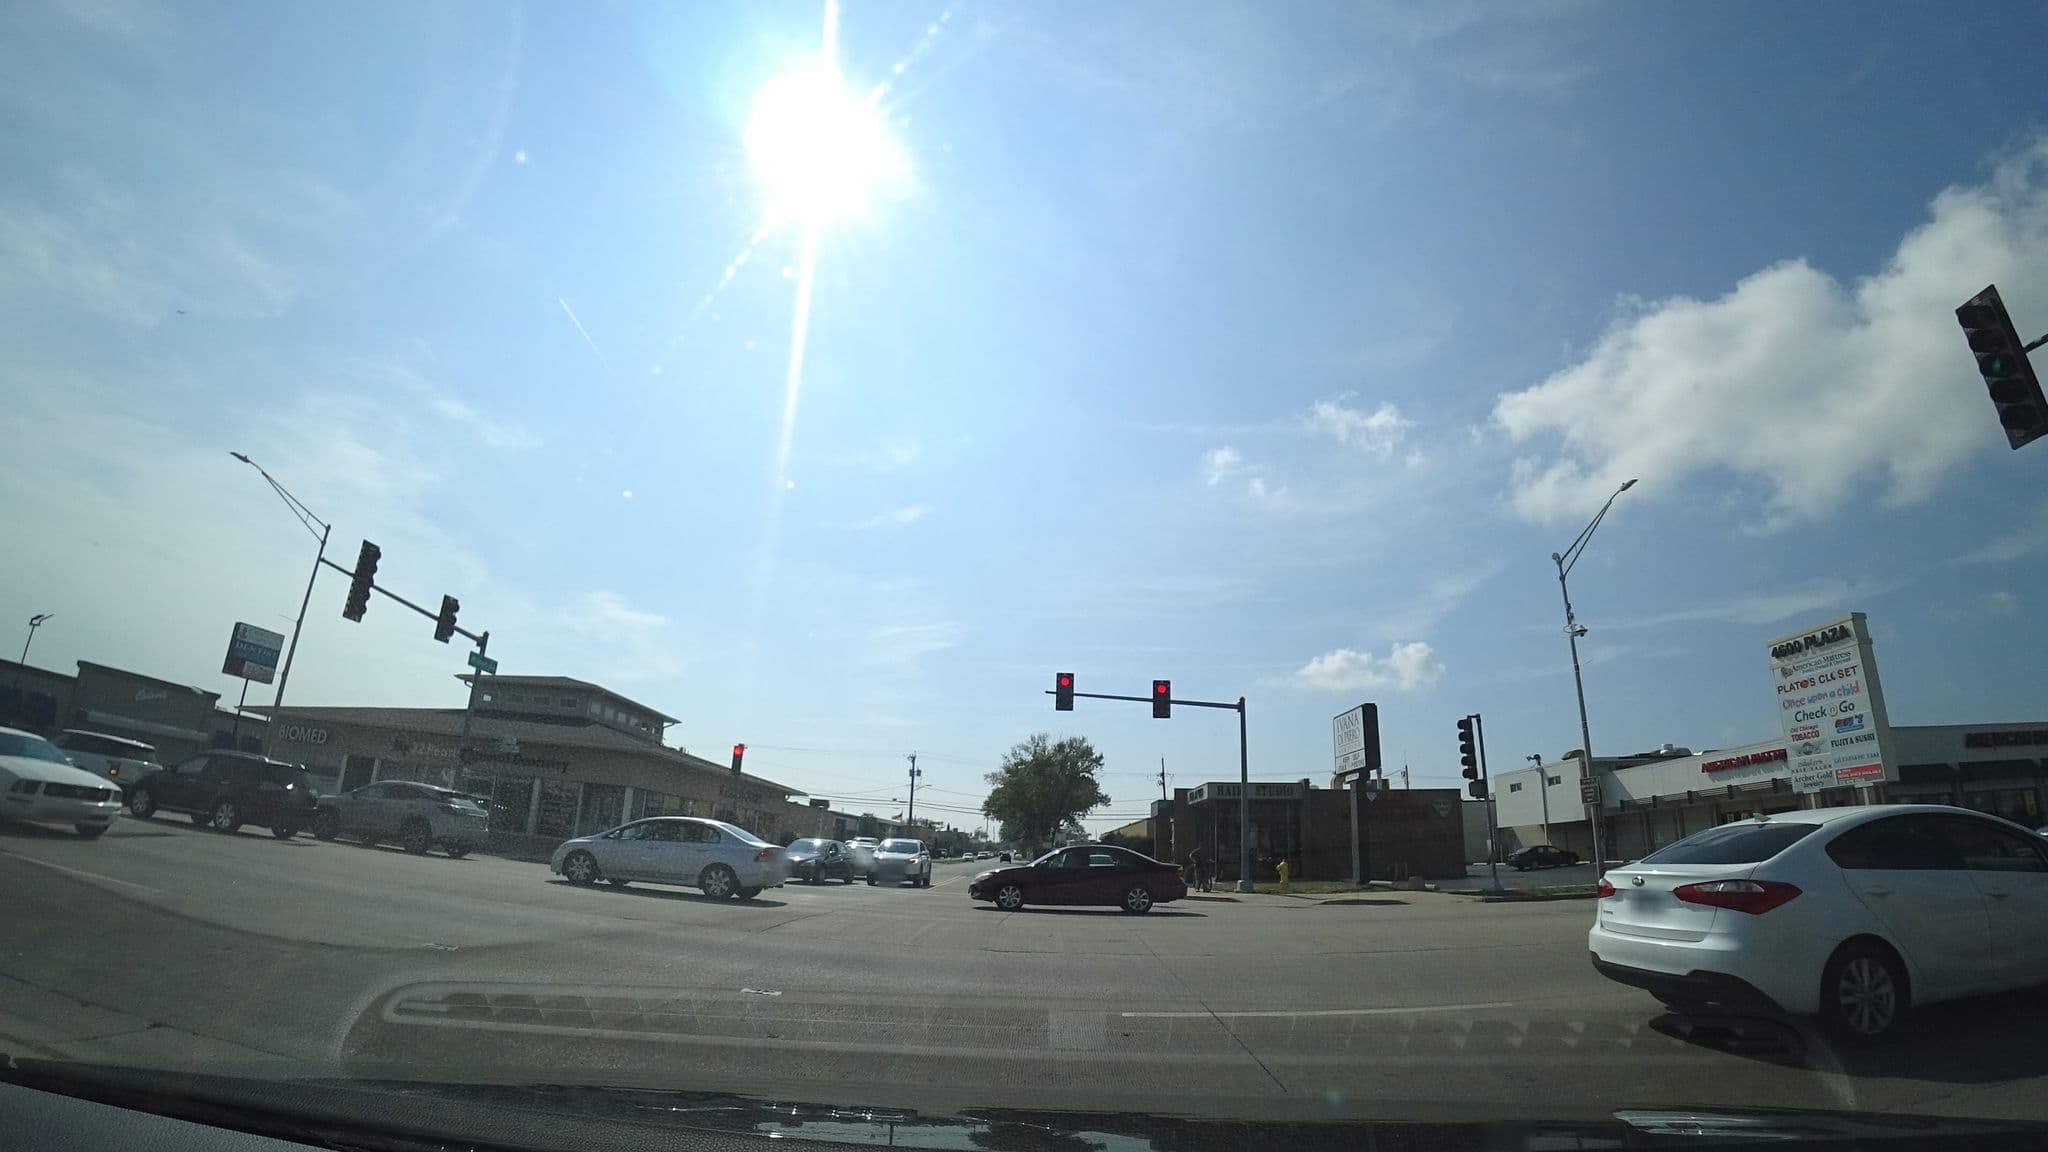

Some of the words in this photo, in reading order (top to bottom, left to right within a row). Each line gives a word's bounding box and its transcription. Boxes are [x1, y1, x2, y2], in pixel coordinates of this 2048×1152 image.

[1771, 640, 1803, 659] 4600
[1803, 625, 1851, 650] PLAZA
[1777, 678, 1816, 694] PLATO'S
[1829, 690, 1836, 699] a
[1836, 680, 1860, 698] child
[1794, 706, 1827, 722] Check
[1838, 700, 1855, 713] Go
[280, 724, 327, 744] BIOMED
[1791, 730, 1820, 742] TOBACCO
[1855, 733, 1876, 744] SUSHI
[1816, 769, 1834, 780] Gold
